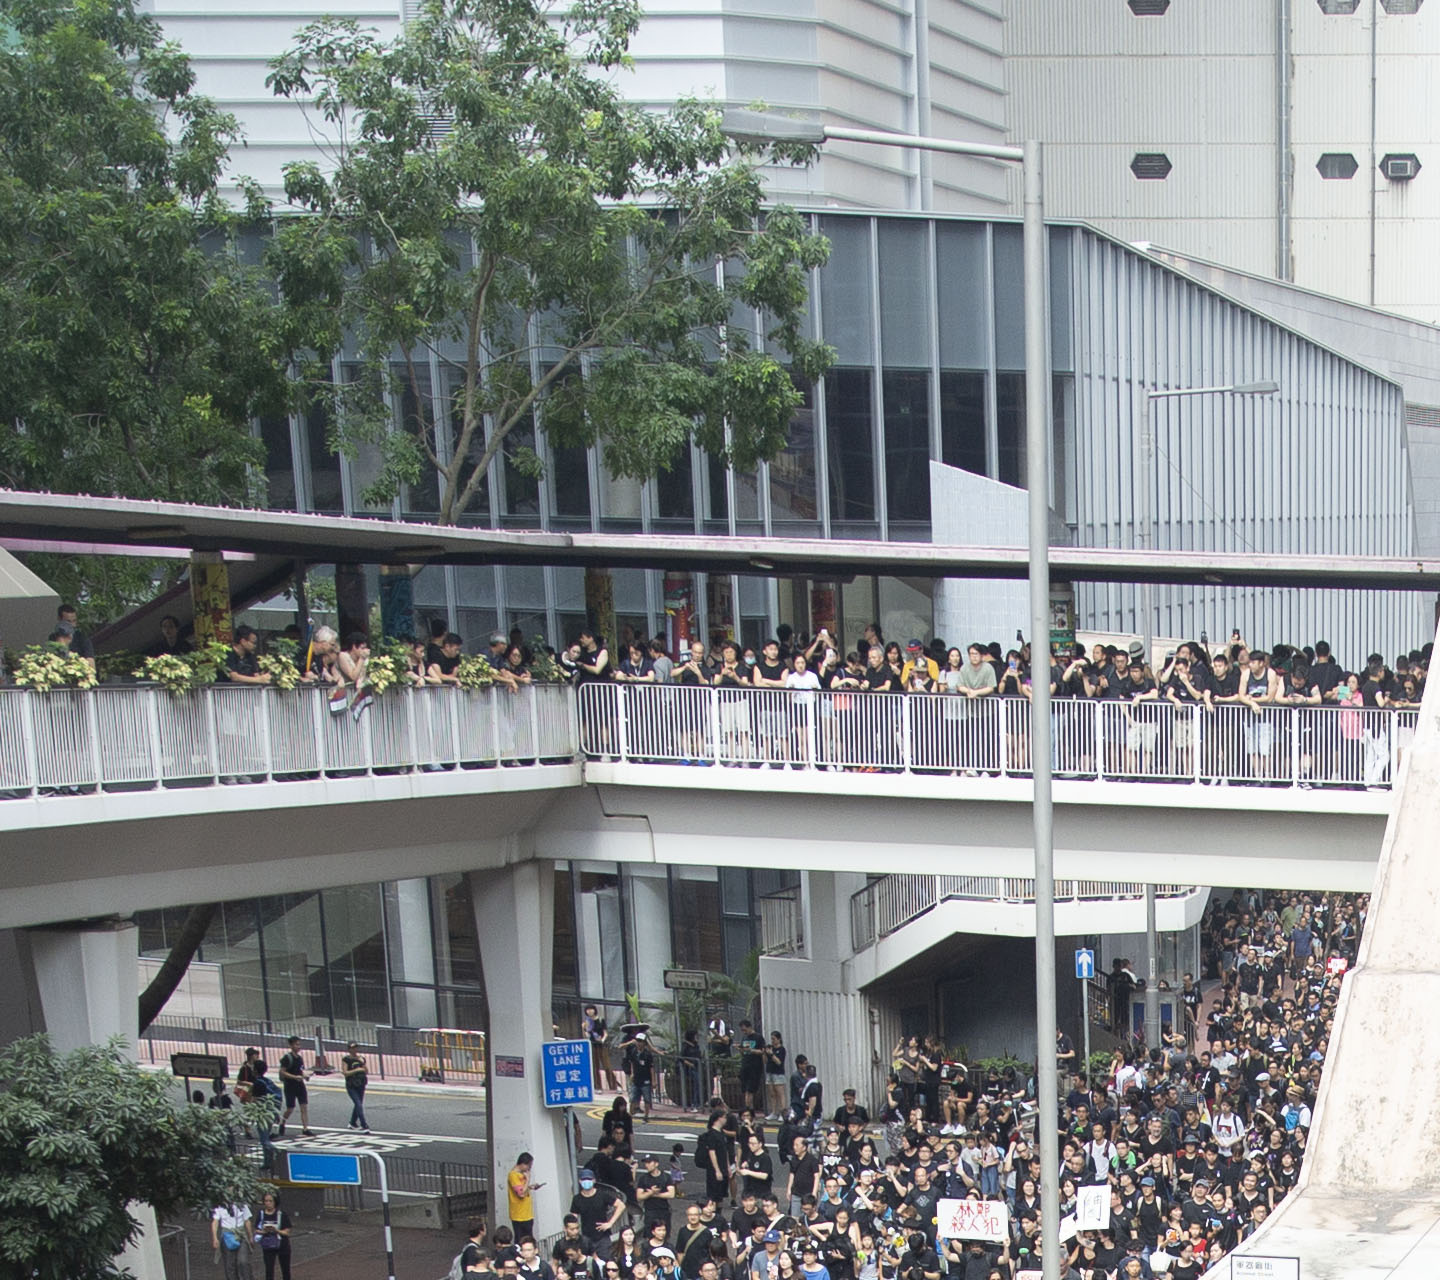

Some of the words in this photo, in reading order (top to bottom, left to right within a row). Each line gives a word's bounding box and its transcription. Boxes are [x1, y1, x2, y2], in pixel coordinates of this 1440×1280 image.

[549, 1044, 569, 1056] GET
[571, 1043, 584, 1054] IN
[553, 1054, 581, 1067] LANE
[555, 1069, 581, 1083] 選定
[958, 1201, 991, 1217] 林鄭
